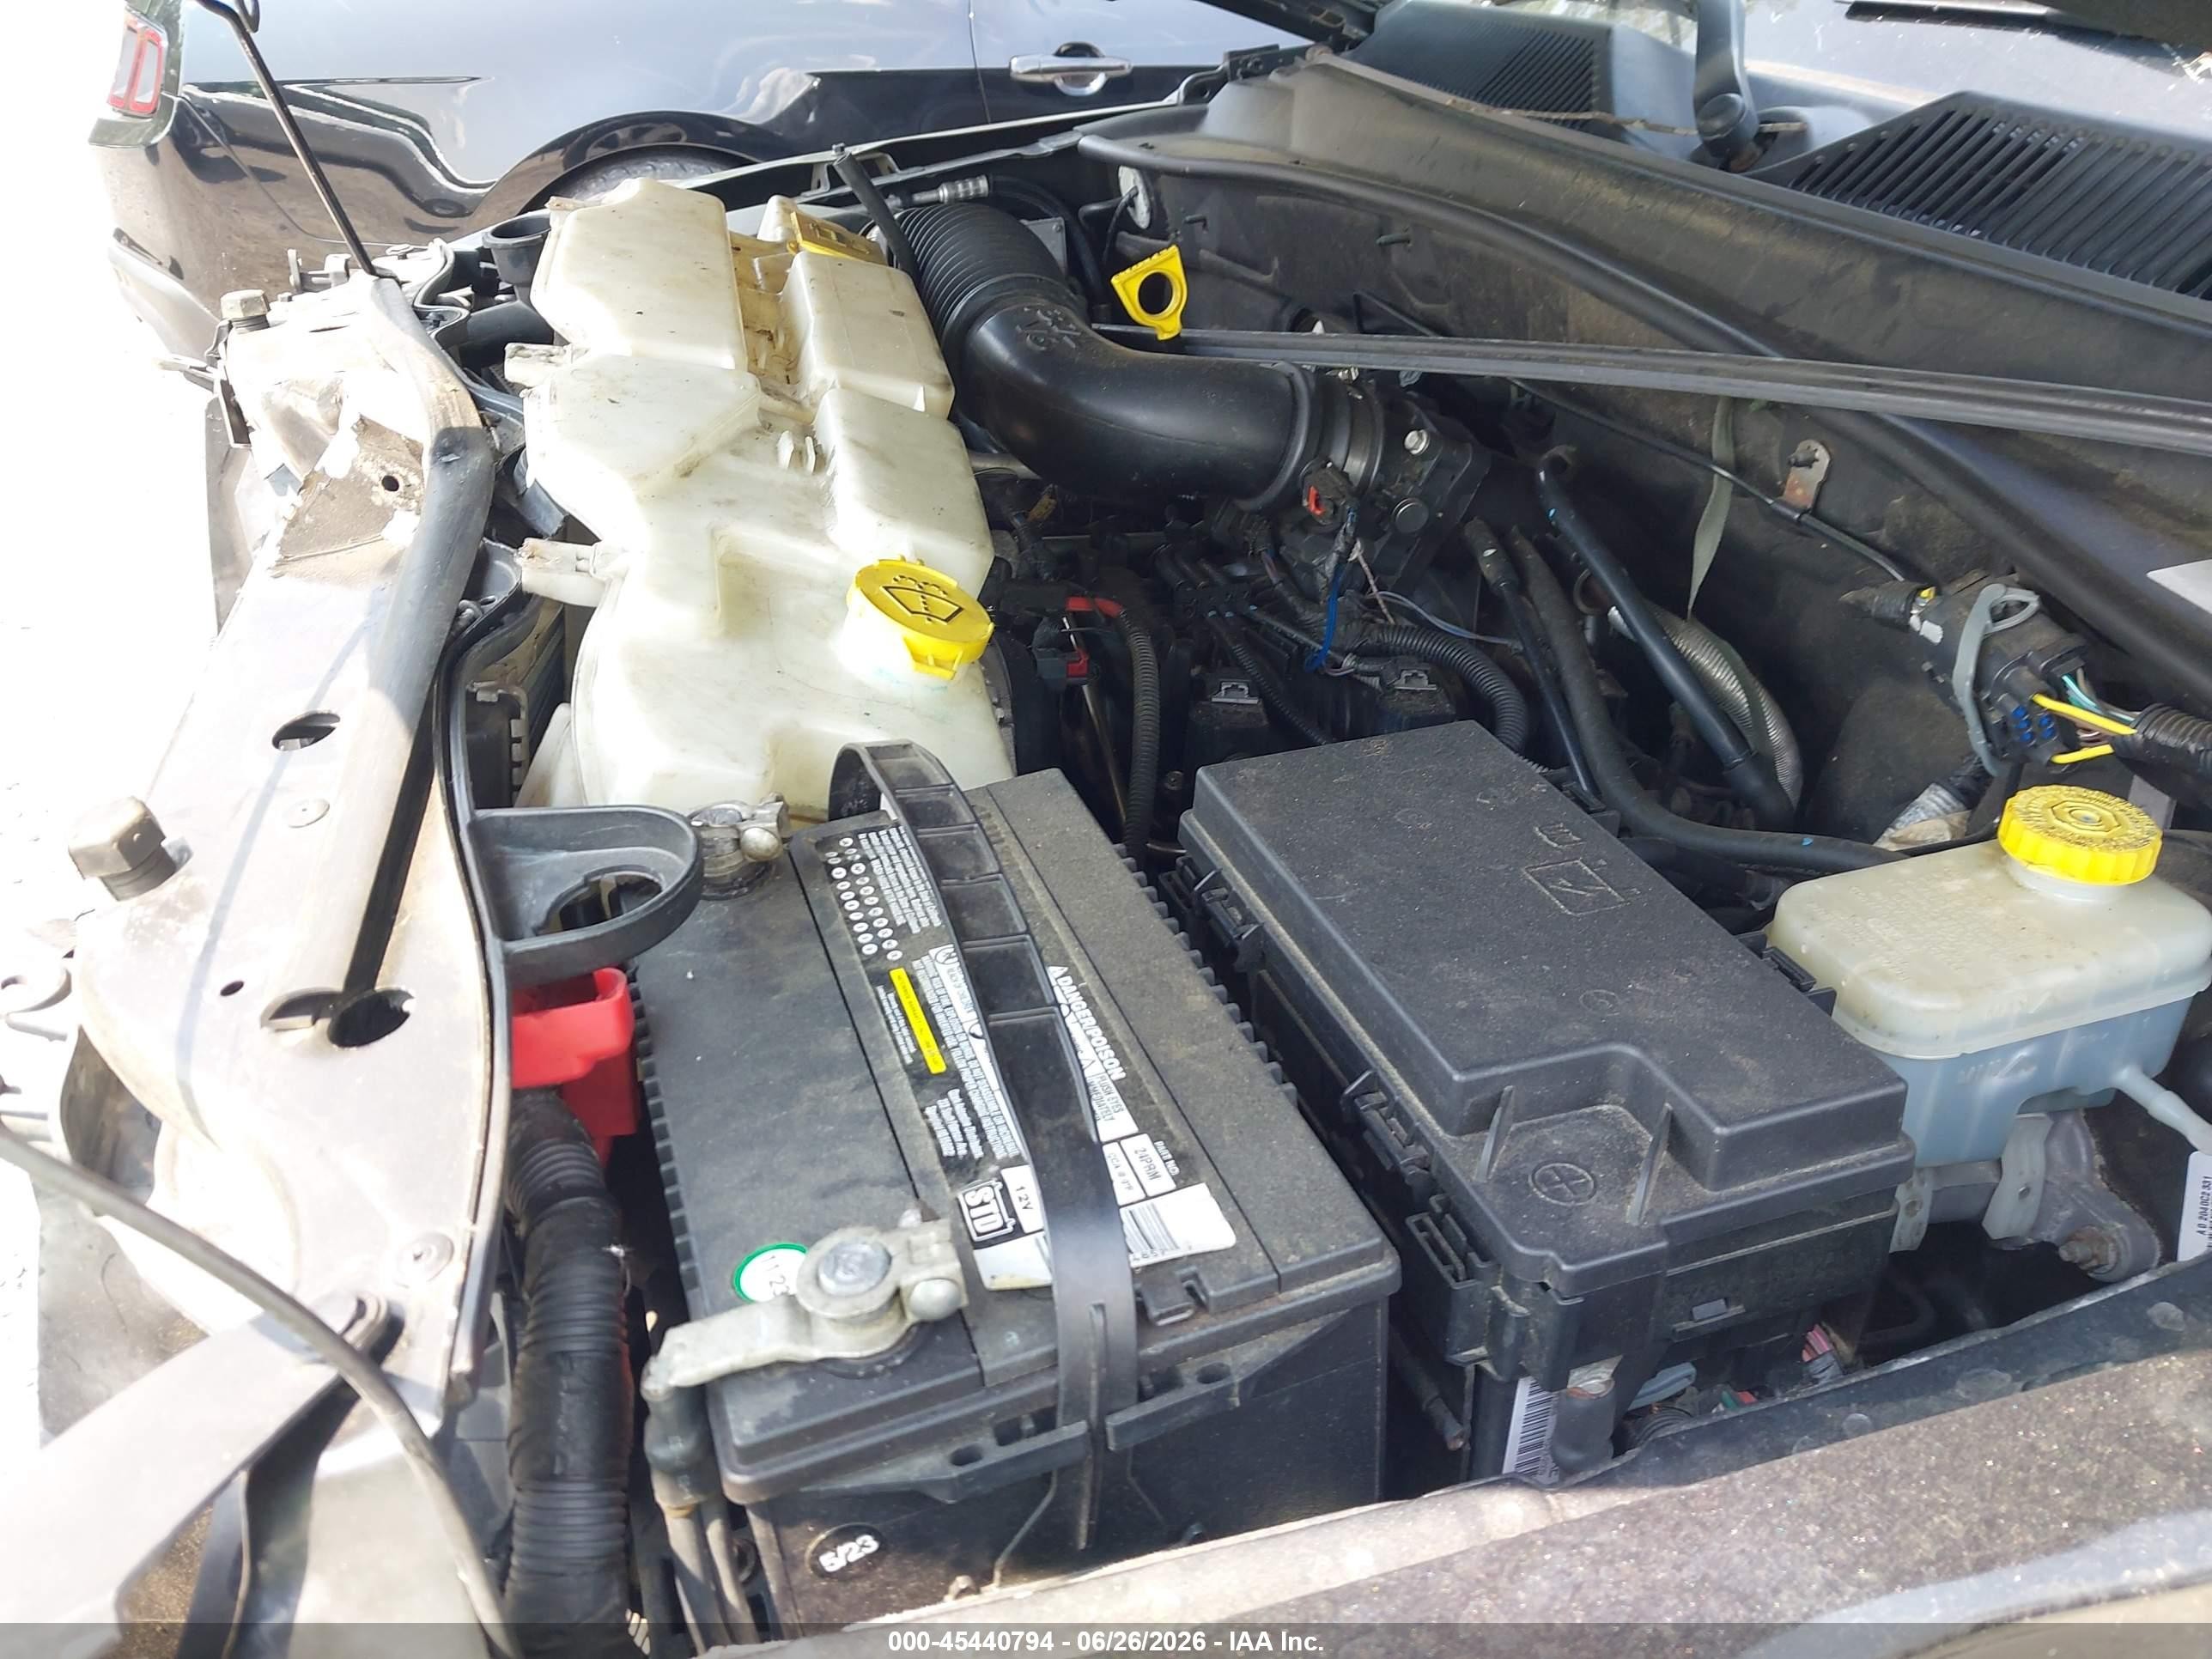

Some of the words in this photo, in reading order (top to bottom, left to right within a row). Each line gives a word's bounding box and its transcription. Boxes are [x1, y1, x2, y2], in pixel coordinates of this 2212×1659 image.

[1056, 975, 1127, 1080] DANGER/POISON
[1107, 1095, 1124, 1114] EYES
[964, 1186, 1004, 1233] STD
[1015, 1185, 1034, 1210] 12V
[818, 1534, 880, 1574] 5/23
